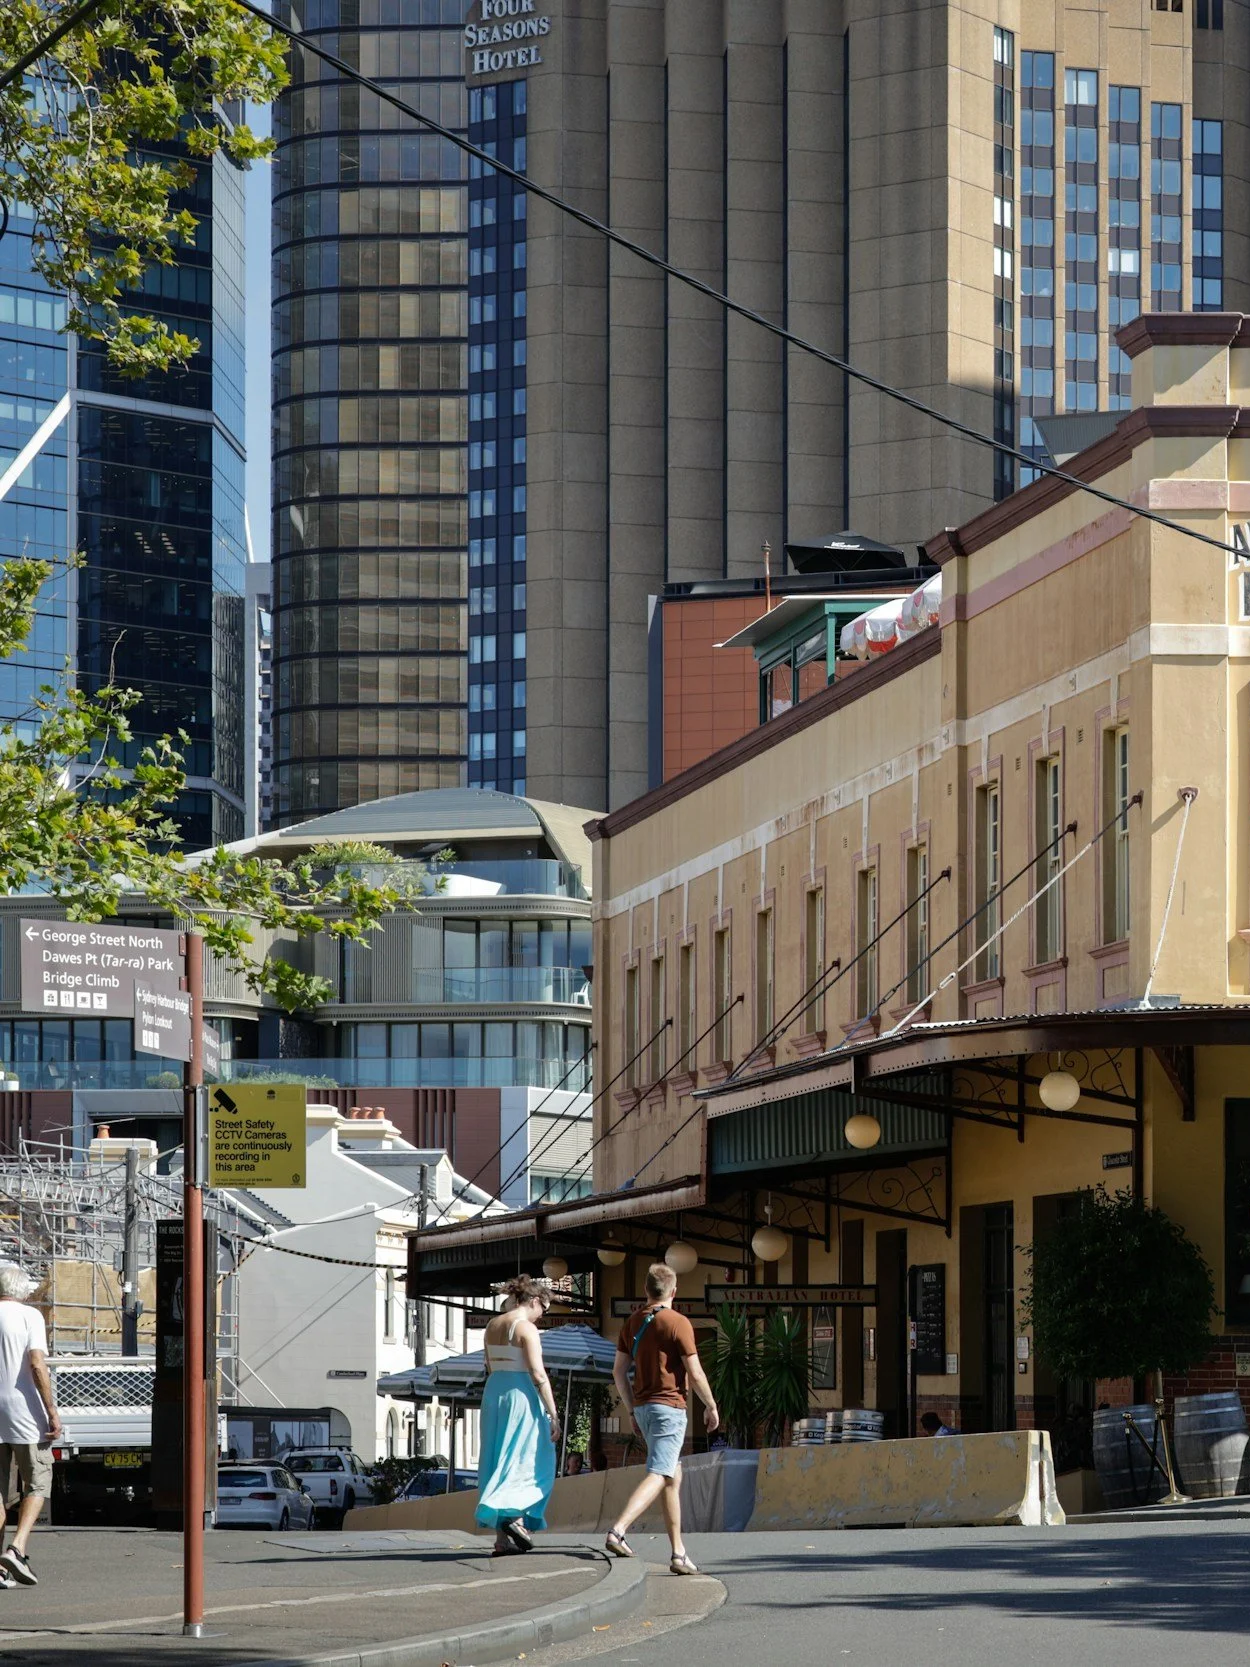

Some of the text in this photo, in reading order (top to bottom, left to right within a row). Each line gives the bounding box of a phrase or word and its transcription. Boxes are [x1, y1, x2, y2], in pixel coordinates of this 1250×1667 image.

[480, 0, 537, 21] FOUR
[464, 16, 551, 48] SEASONS
[472, 45, 543, 75] HOTEL
[42, 929, 163, 949] George Street North
[42, 950, 174, 971] Dawes Pt (Tar-ra) Park
[43, 971, 120, 988] Bridge Climb
[142, 989, 189, 1015] Sydney Harbour Bridge
[154, 1013, 173, 1030] Lookout
[215, 1119, 275, 1131] Street Safety
[215, 1130, 287, 1140] CCTV Cameras
[232, 1141, 292, 1152] continuously
[215, 1152, 270, 1162] recording in
[215, 1162, 232, 1171] this
[158, 1226, 168, 1234] THE
[723, 1290, 864, 1301] AUSTRALIAN HOTEL
[630, 1303, 694, 1313] GOET
[118, 1454, 129, 1464] 75
